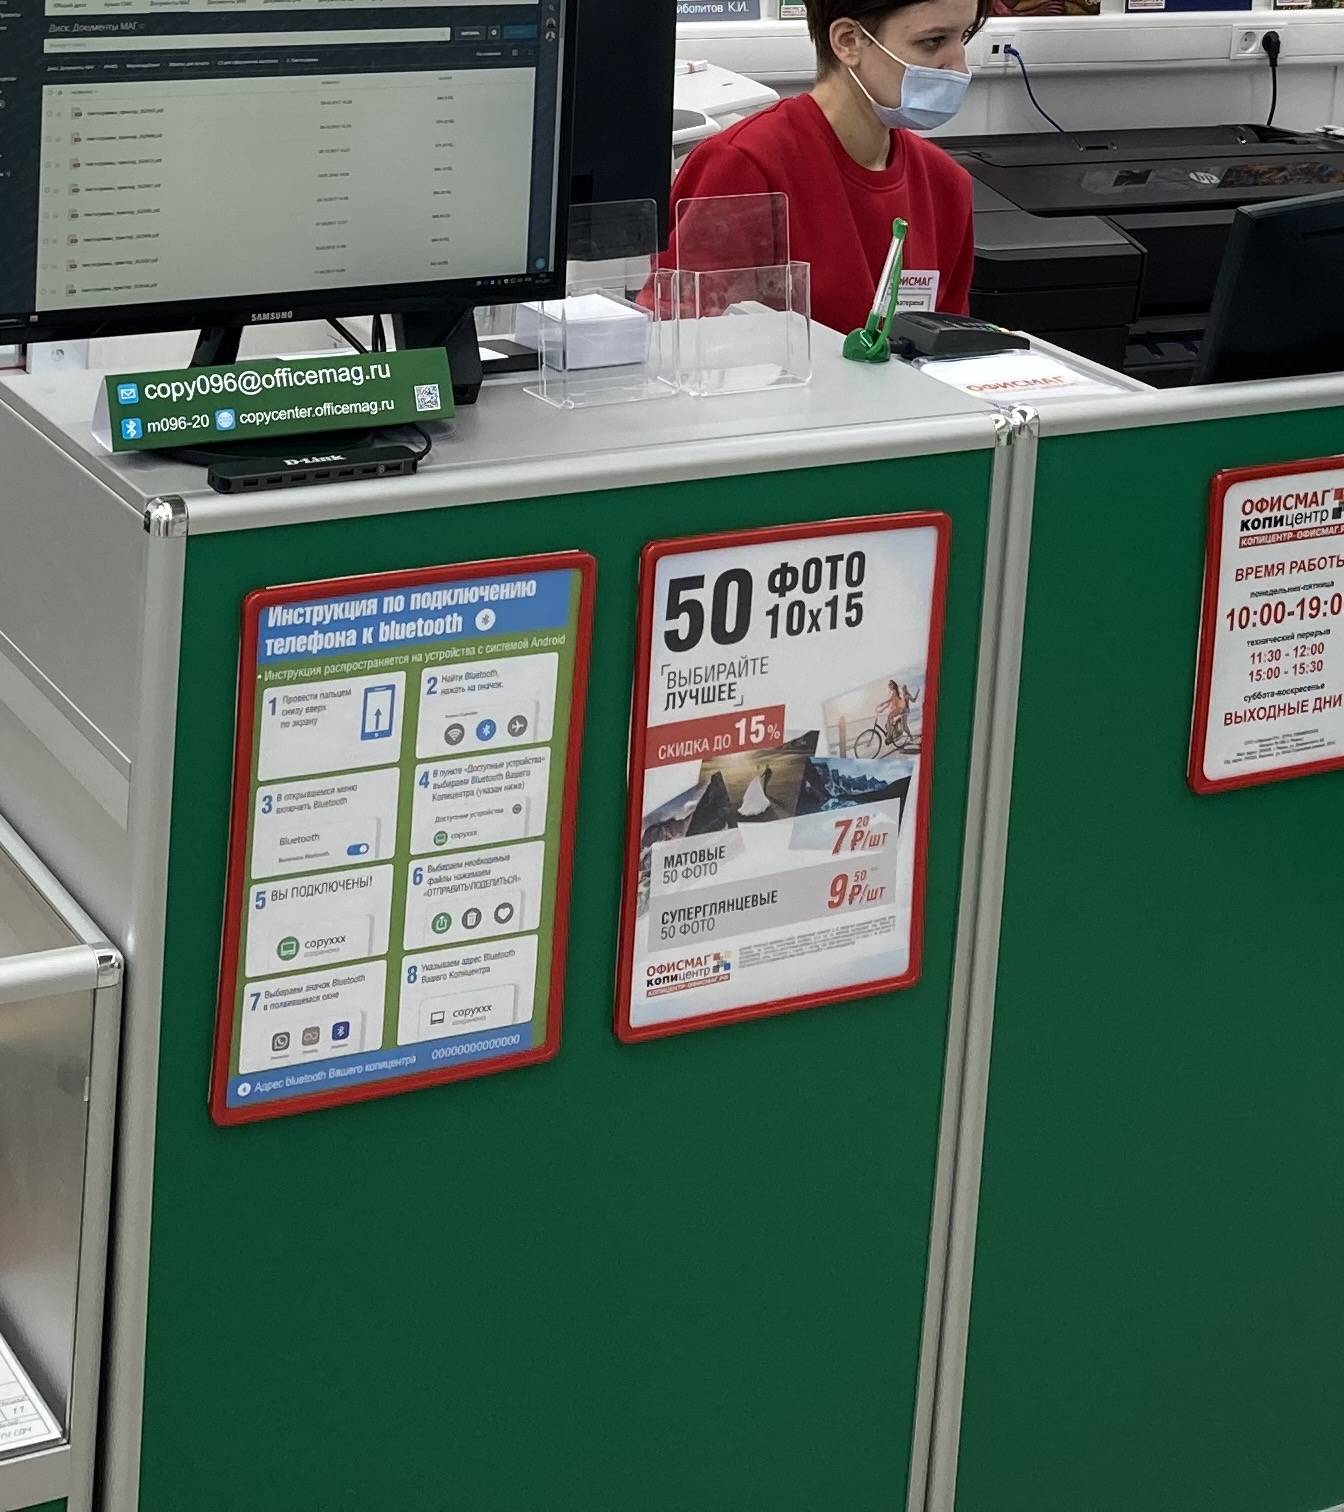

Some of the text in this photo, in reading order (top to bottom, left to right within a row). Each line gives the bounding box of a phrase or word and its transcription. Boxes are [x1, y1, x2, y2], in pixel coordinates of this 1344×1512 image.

[676, 4, 724, 15] йболитов
[899, 276, 934, 287] ИСМАГ
[251, 309, 294, 323] SAMSUNG
[144, 363, 391, 402] copy096@officemag.ru
[147, 399, 395, 433] m096-20 copycenter.officemag.ru
[283, 454, 348, 467] D-Link
[1241, 489, 1331, 516] ОФИСМАГ
[1240, 508, 1329, 533] копицентр
[767, 550, 866, 598] ФОТО
[1234, 561, 1286, 583] ВРЕМЯ
[268, 579, 537, 628] Инструкция по подключению
[663, 567, 754, 653] 50
[266, 613, 463, 656] телефона bluetooth
[1247, 628, 1331, 648] технический перерыв
[264, 633, 567, 682] Инструкция распространяется устройства Android
[1250, 642, 1325, 666] 11:30 12:00
[666, 655, 770, 690] ВЫБИРАЙТЕ
[1248, 659, 1324, 683] 15:00 15:30
[664, 681, 738, 712] ЛУЧШЕЕ
[1223, 693, 1343, 727] ВЫХОДНЫЕ ДНИ
[658, 715, 781, 760] СКИДКА ДО 15%
[664, 844, 727, 870] МАТОВЫЕ
[662, 861, 719, 885] 50 ФОТО
[291, 875, 374, 899] ПОДКЛЮЧЕНЫ!
[661, 889, 779, 926] СУПЕРГЛЯНЦЕВЫЕ
[660, 917, 716, 941] 50 ФОТО
[646, 954, 712, 977] ОФИСМАГ
[646, 965, 711, 988] копицентр
